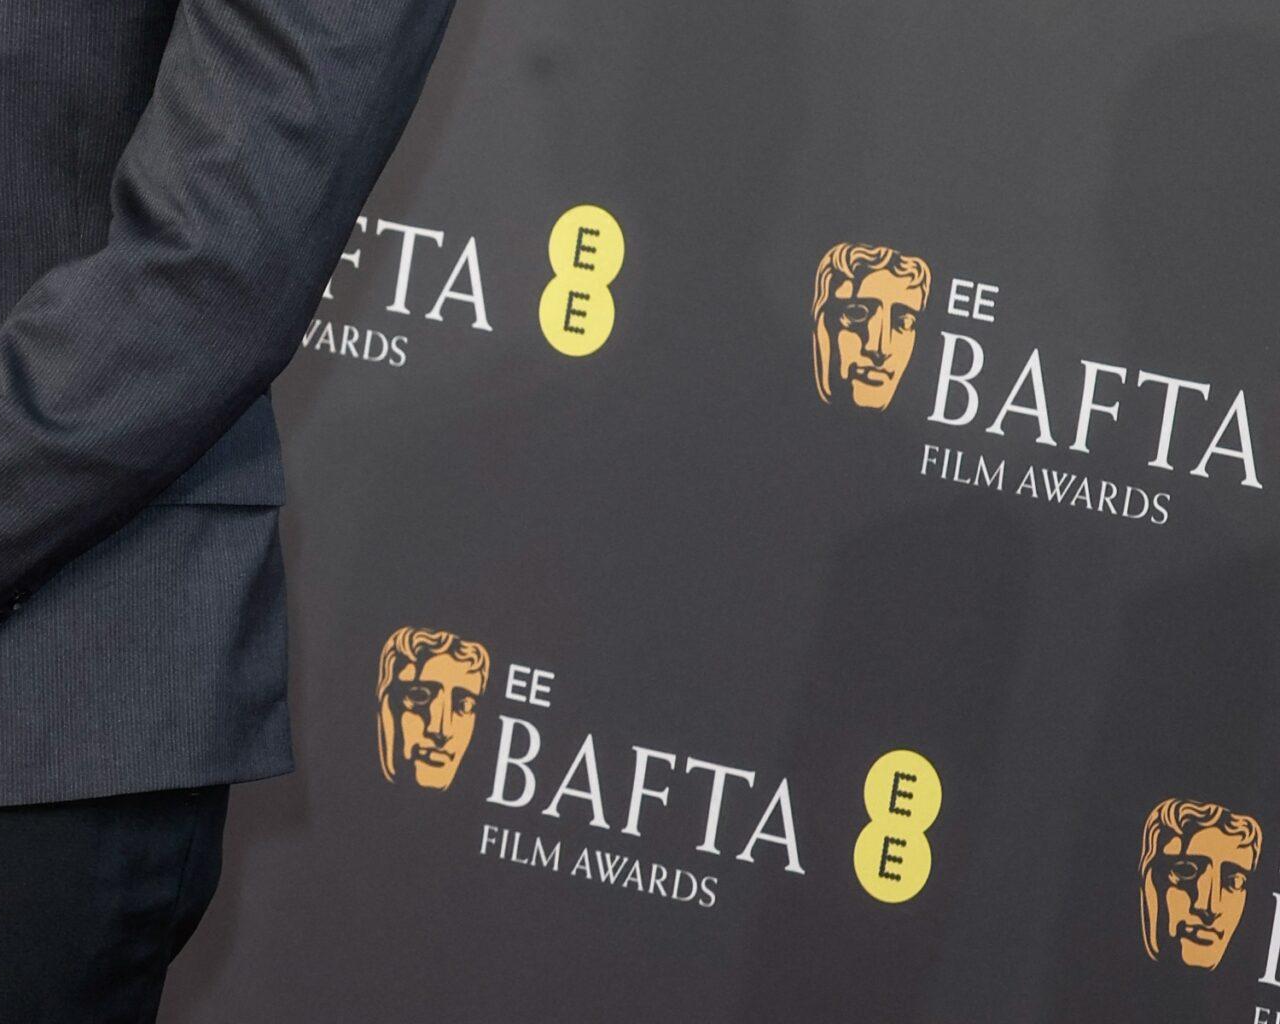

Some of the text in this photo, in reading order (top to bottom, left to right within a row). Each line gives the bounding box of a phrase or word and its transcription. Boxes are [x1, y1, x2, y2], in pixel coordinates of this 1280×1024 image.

[947, 277, 1000, 323] EE
[926, 330, 1263, 490] BAFTA
[920, 443, 1171, 525] FILM AWARDS
[504, 663, 556, 709] EE
[485, 714, 806, 876] BAFTA
[479, 823, 718, 908] FILM AWARDS
